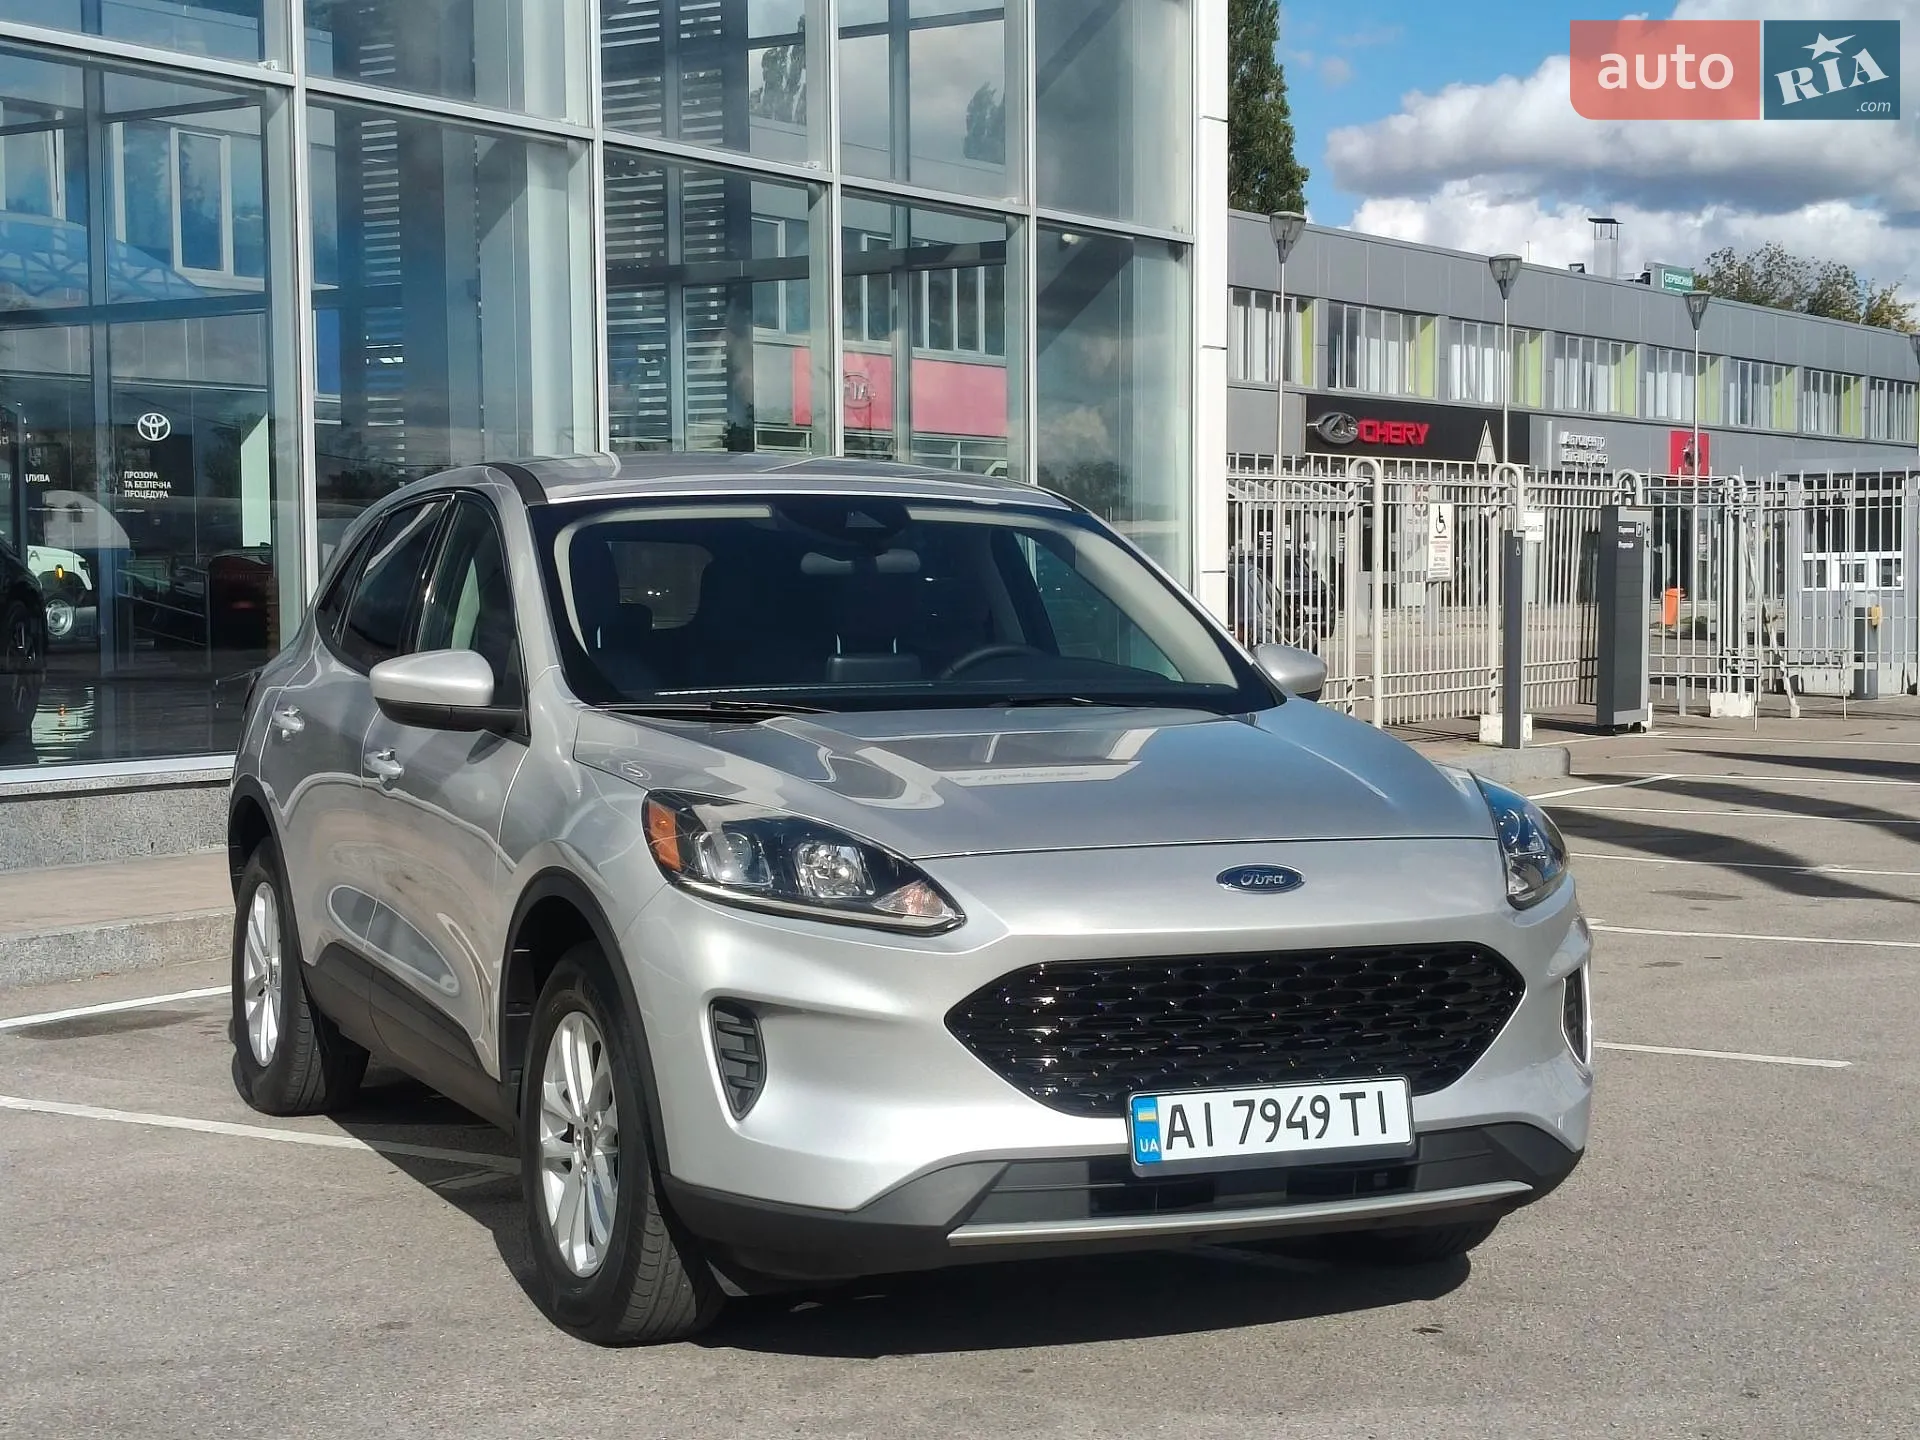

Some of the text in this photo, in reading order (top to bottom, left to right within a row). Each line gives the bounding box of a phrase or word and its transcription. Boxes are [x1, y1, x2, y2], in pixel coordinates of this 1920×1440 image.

[1358, 419, 1429, 444] CHERY
[124, 471, 159, 480] ПРОЗОРА
[124, 480, 172, 489] ТА БЕЗПЕЧНА
[124, 489, 169, 500] ПРОЦЕДУРА
[1240, 870, 1287, 886] Ford
[1165, 1090, 1388, 1150] AI 7949 TI
[1139, 1138, 1160, 1153] UA
